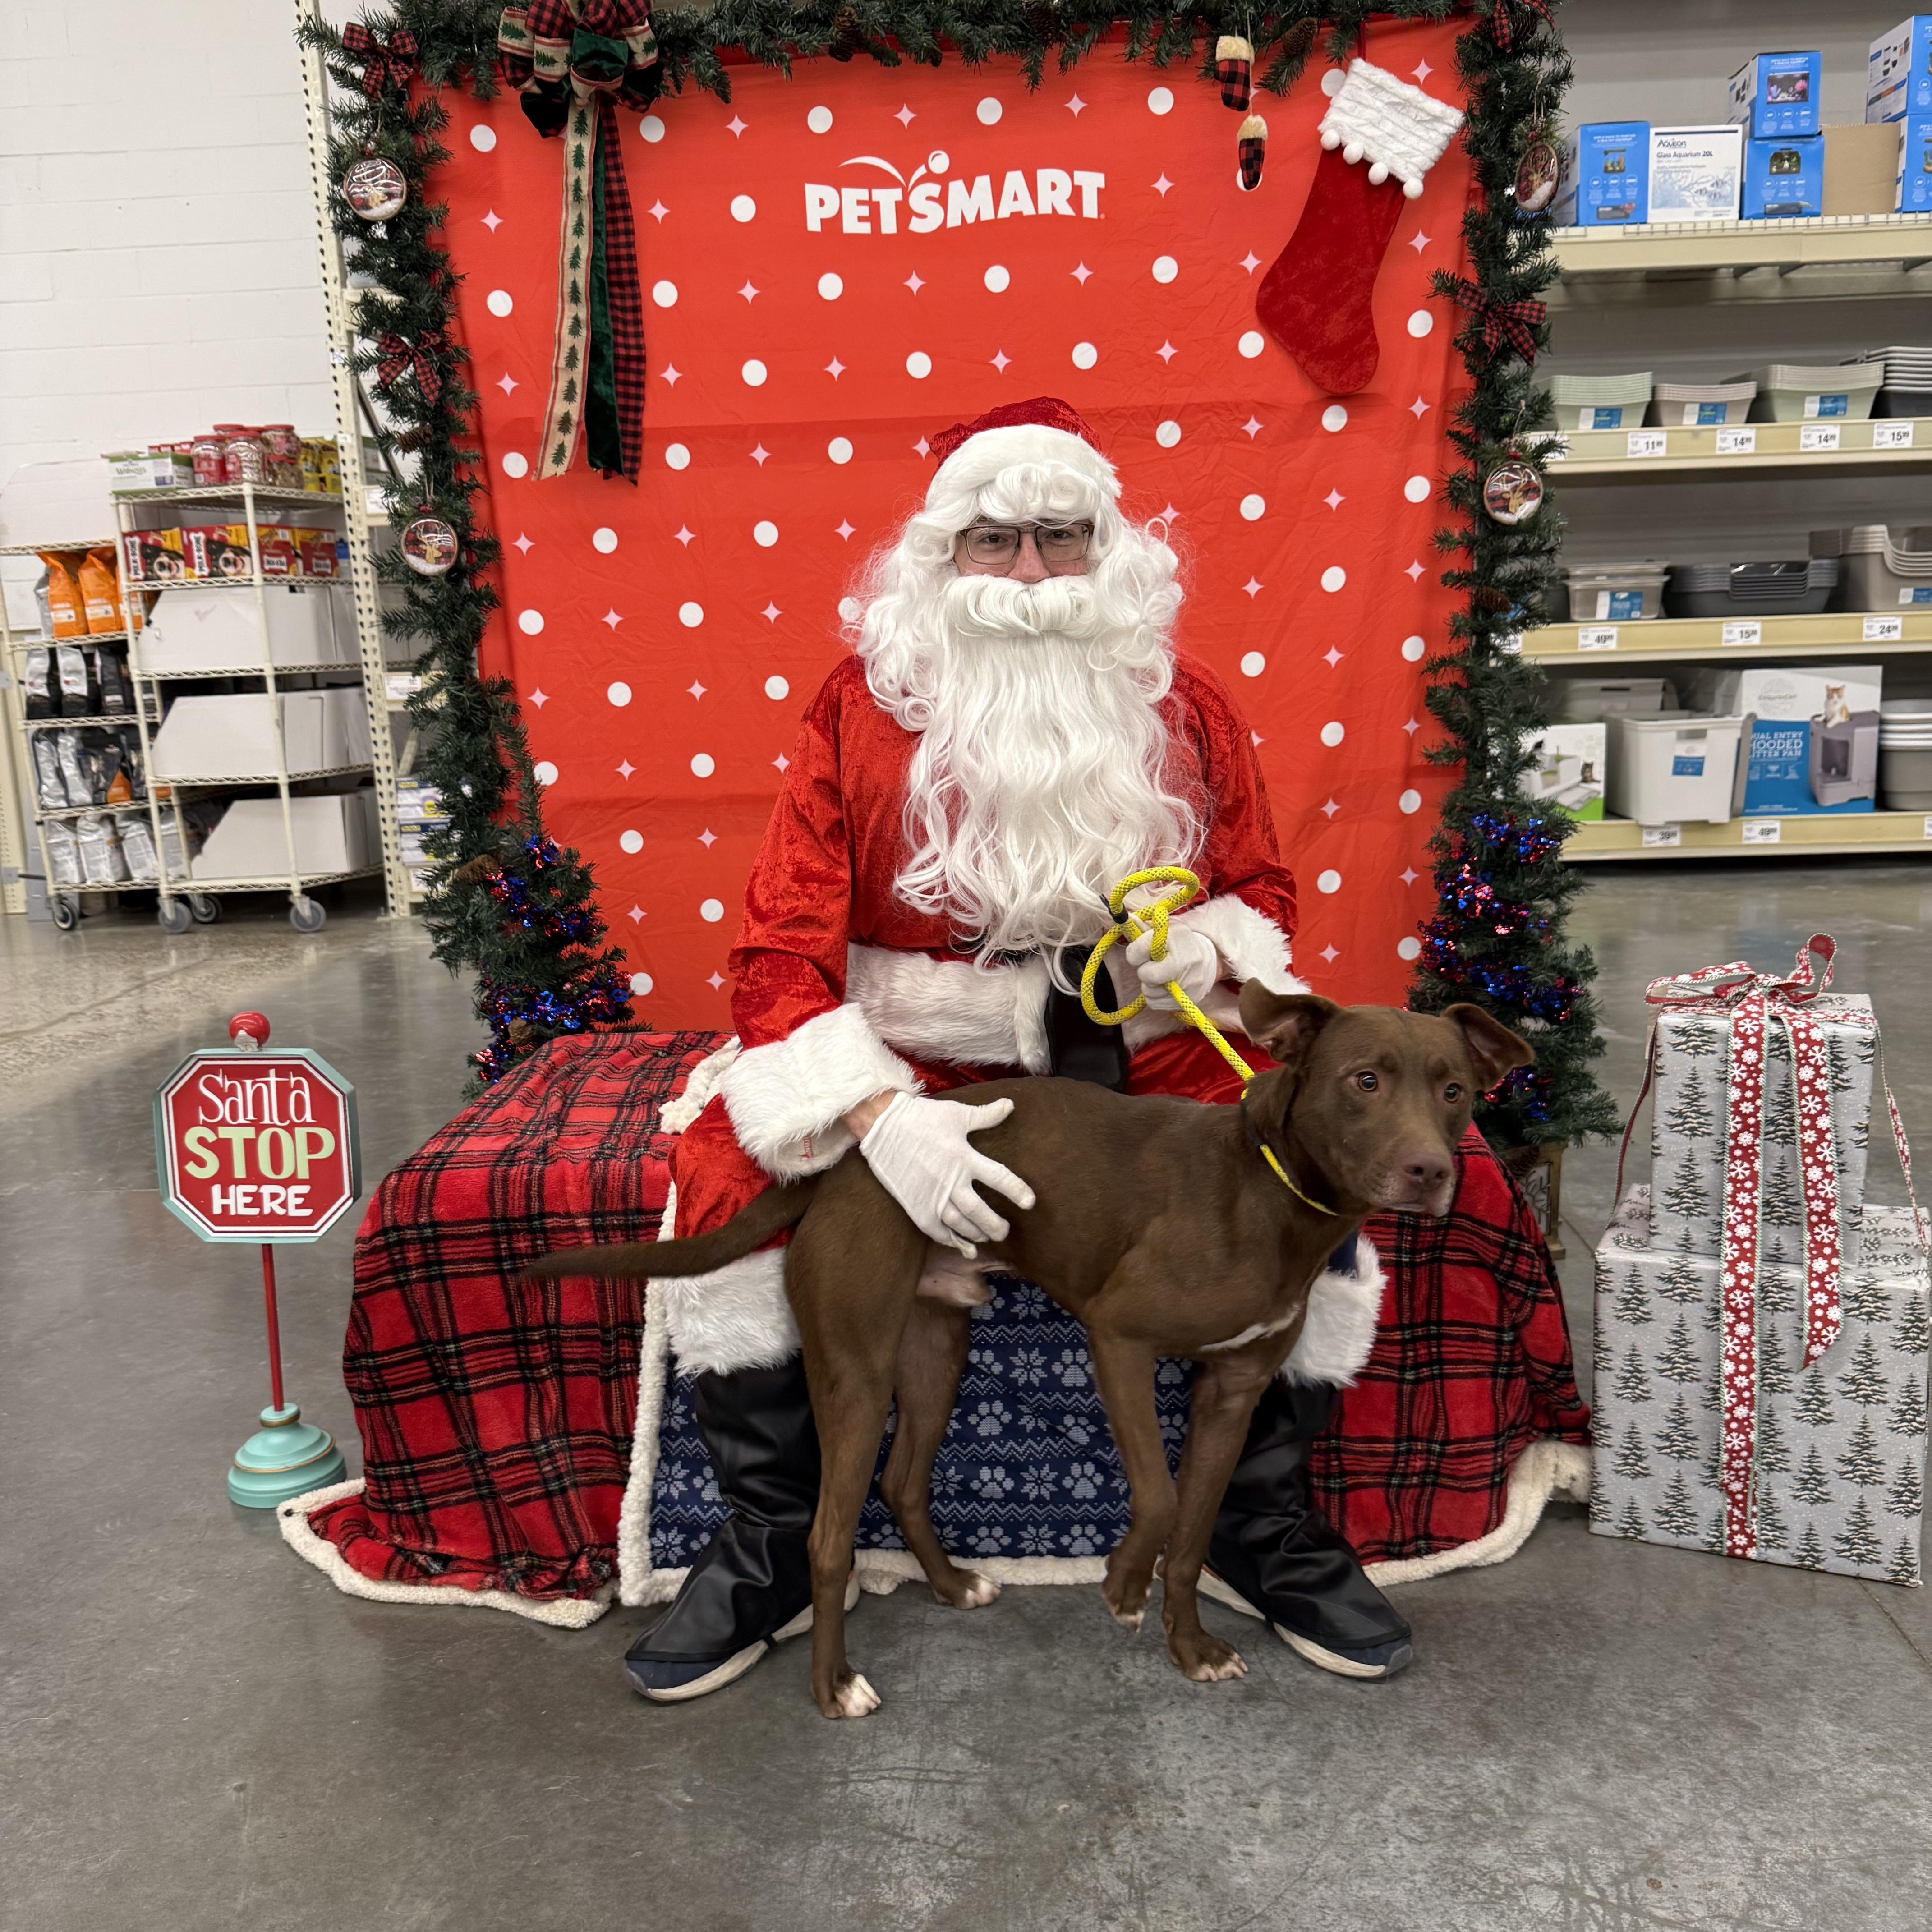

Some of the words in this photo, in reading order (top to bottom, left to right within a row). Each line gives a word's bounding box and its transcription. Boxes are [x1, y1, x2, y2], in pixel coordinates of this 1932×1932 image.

[1672, 150, 1701, 158] Aquarium
[805, 168, 1105, 234] PETSMART
[1749, 749, 1780, 758] ITTER
[1782, 748, 1802, 757] PAN
[199, 1068, 317, 1126] Santa
[184, 1126, 336, 1179] STOP
[211, 1184, 314, 1217] HERE
